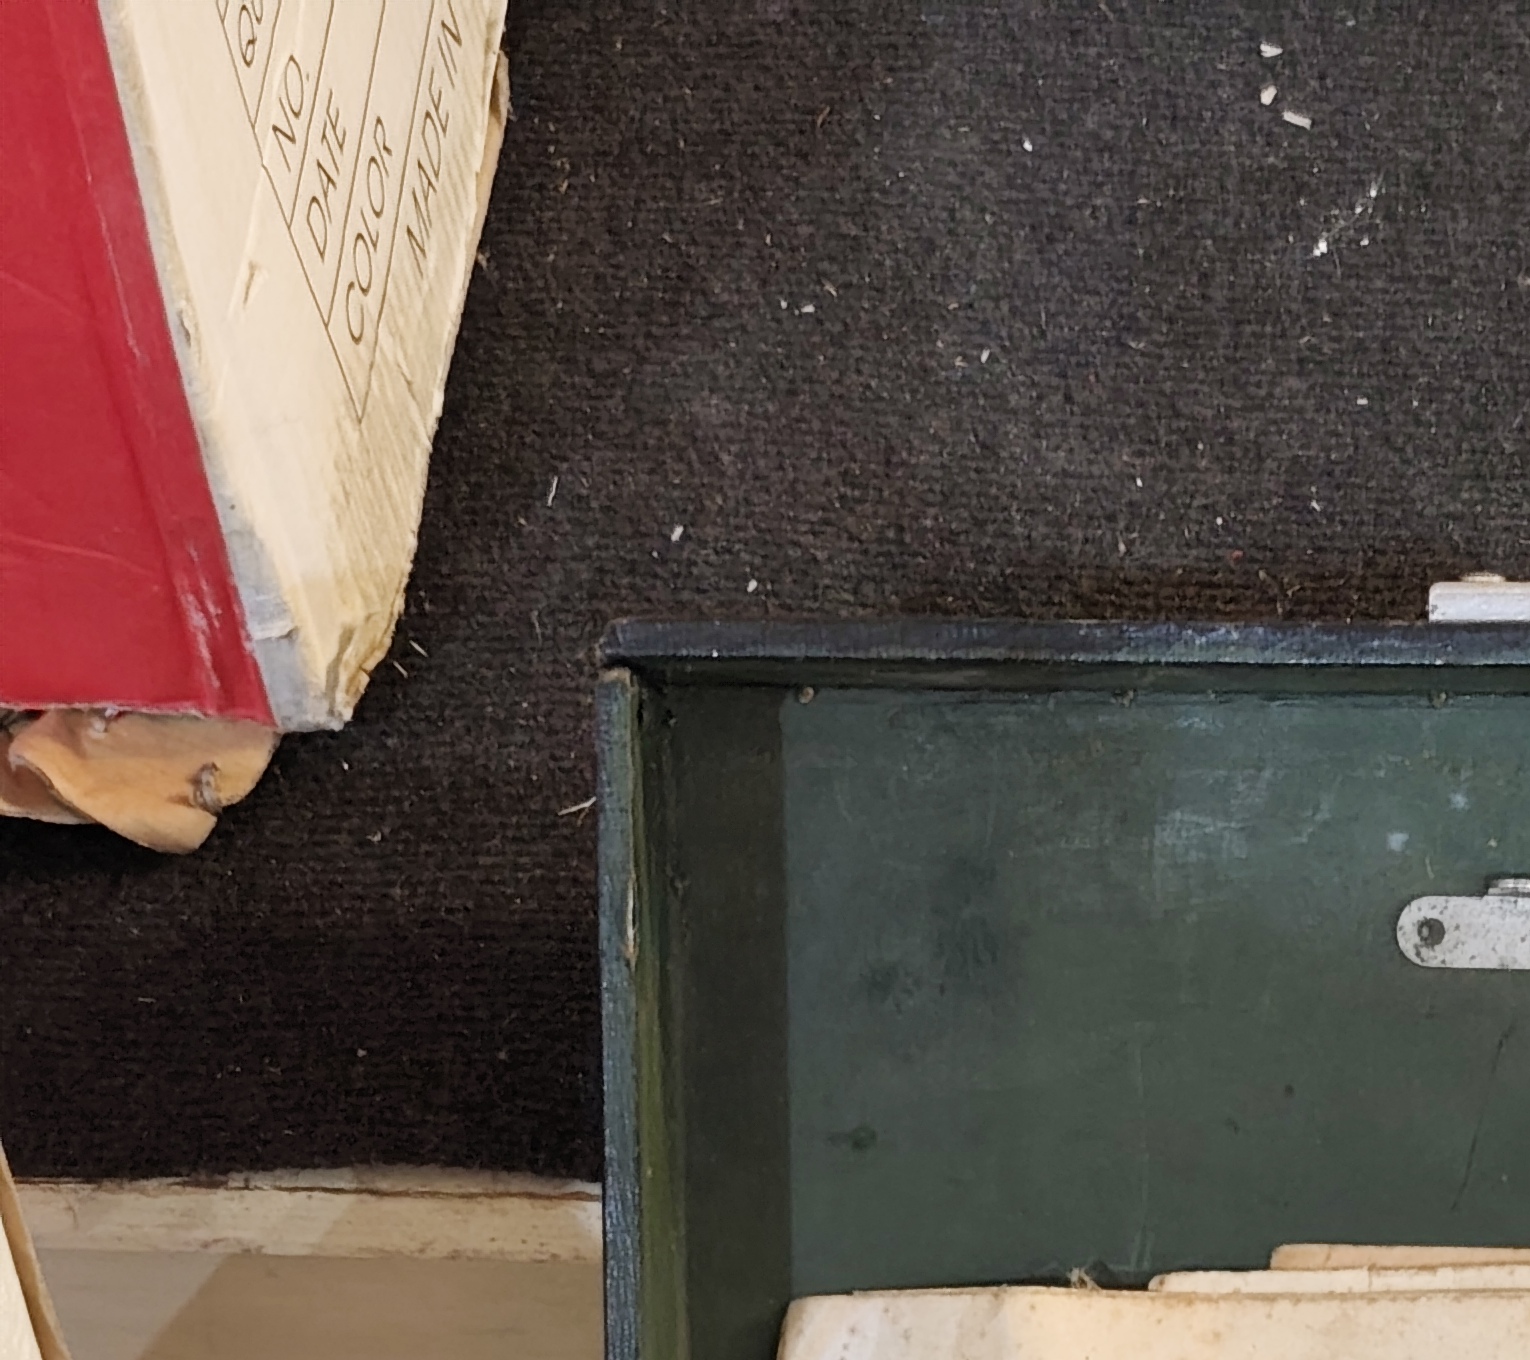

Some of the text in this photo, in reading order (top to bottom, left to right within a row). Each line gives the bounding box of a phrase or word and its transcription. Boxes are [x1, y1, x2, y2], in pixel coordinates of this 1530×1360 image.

[271, 54, 310, 174] NO.
[306, 88, 347, 264] DATE
[406, 0, 463, 280] MADE IN
[345, 115, 393, 346] COLOR
